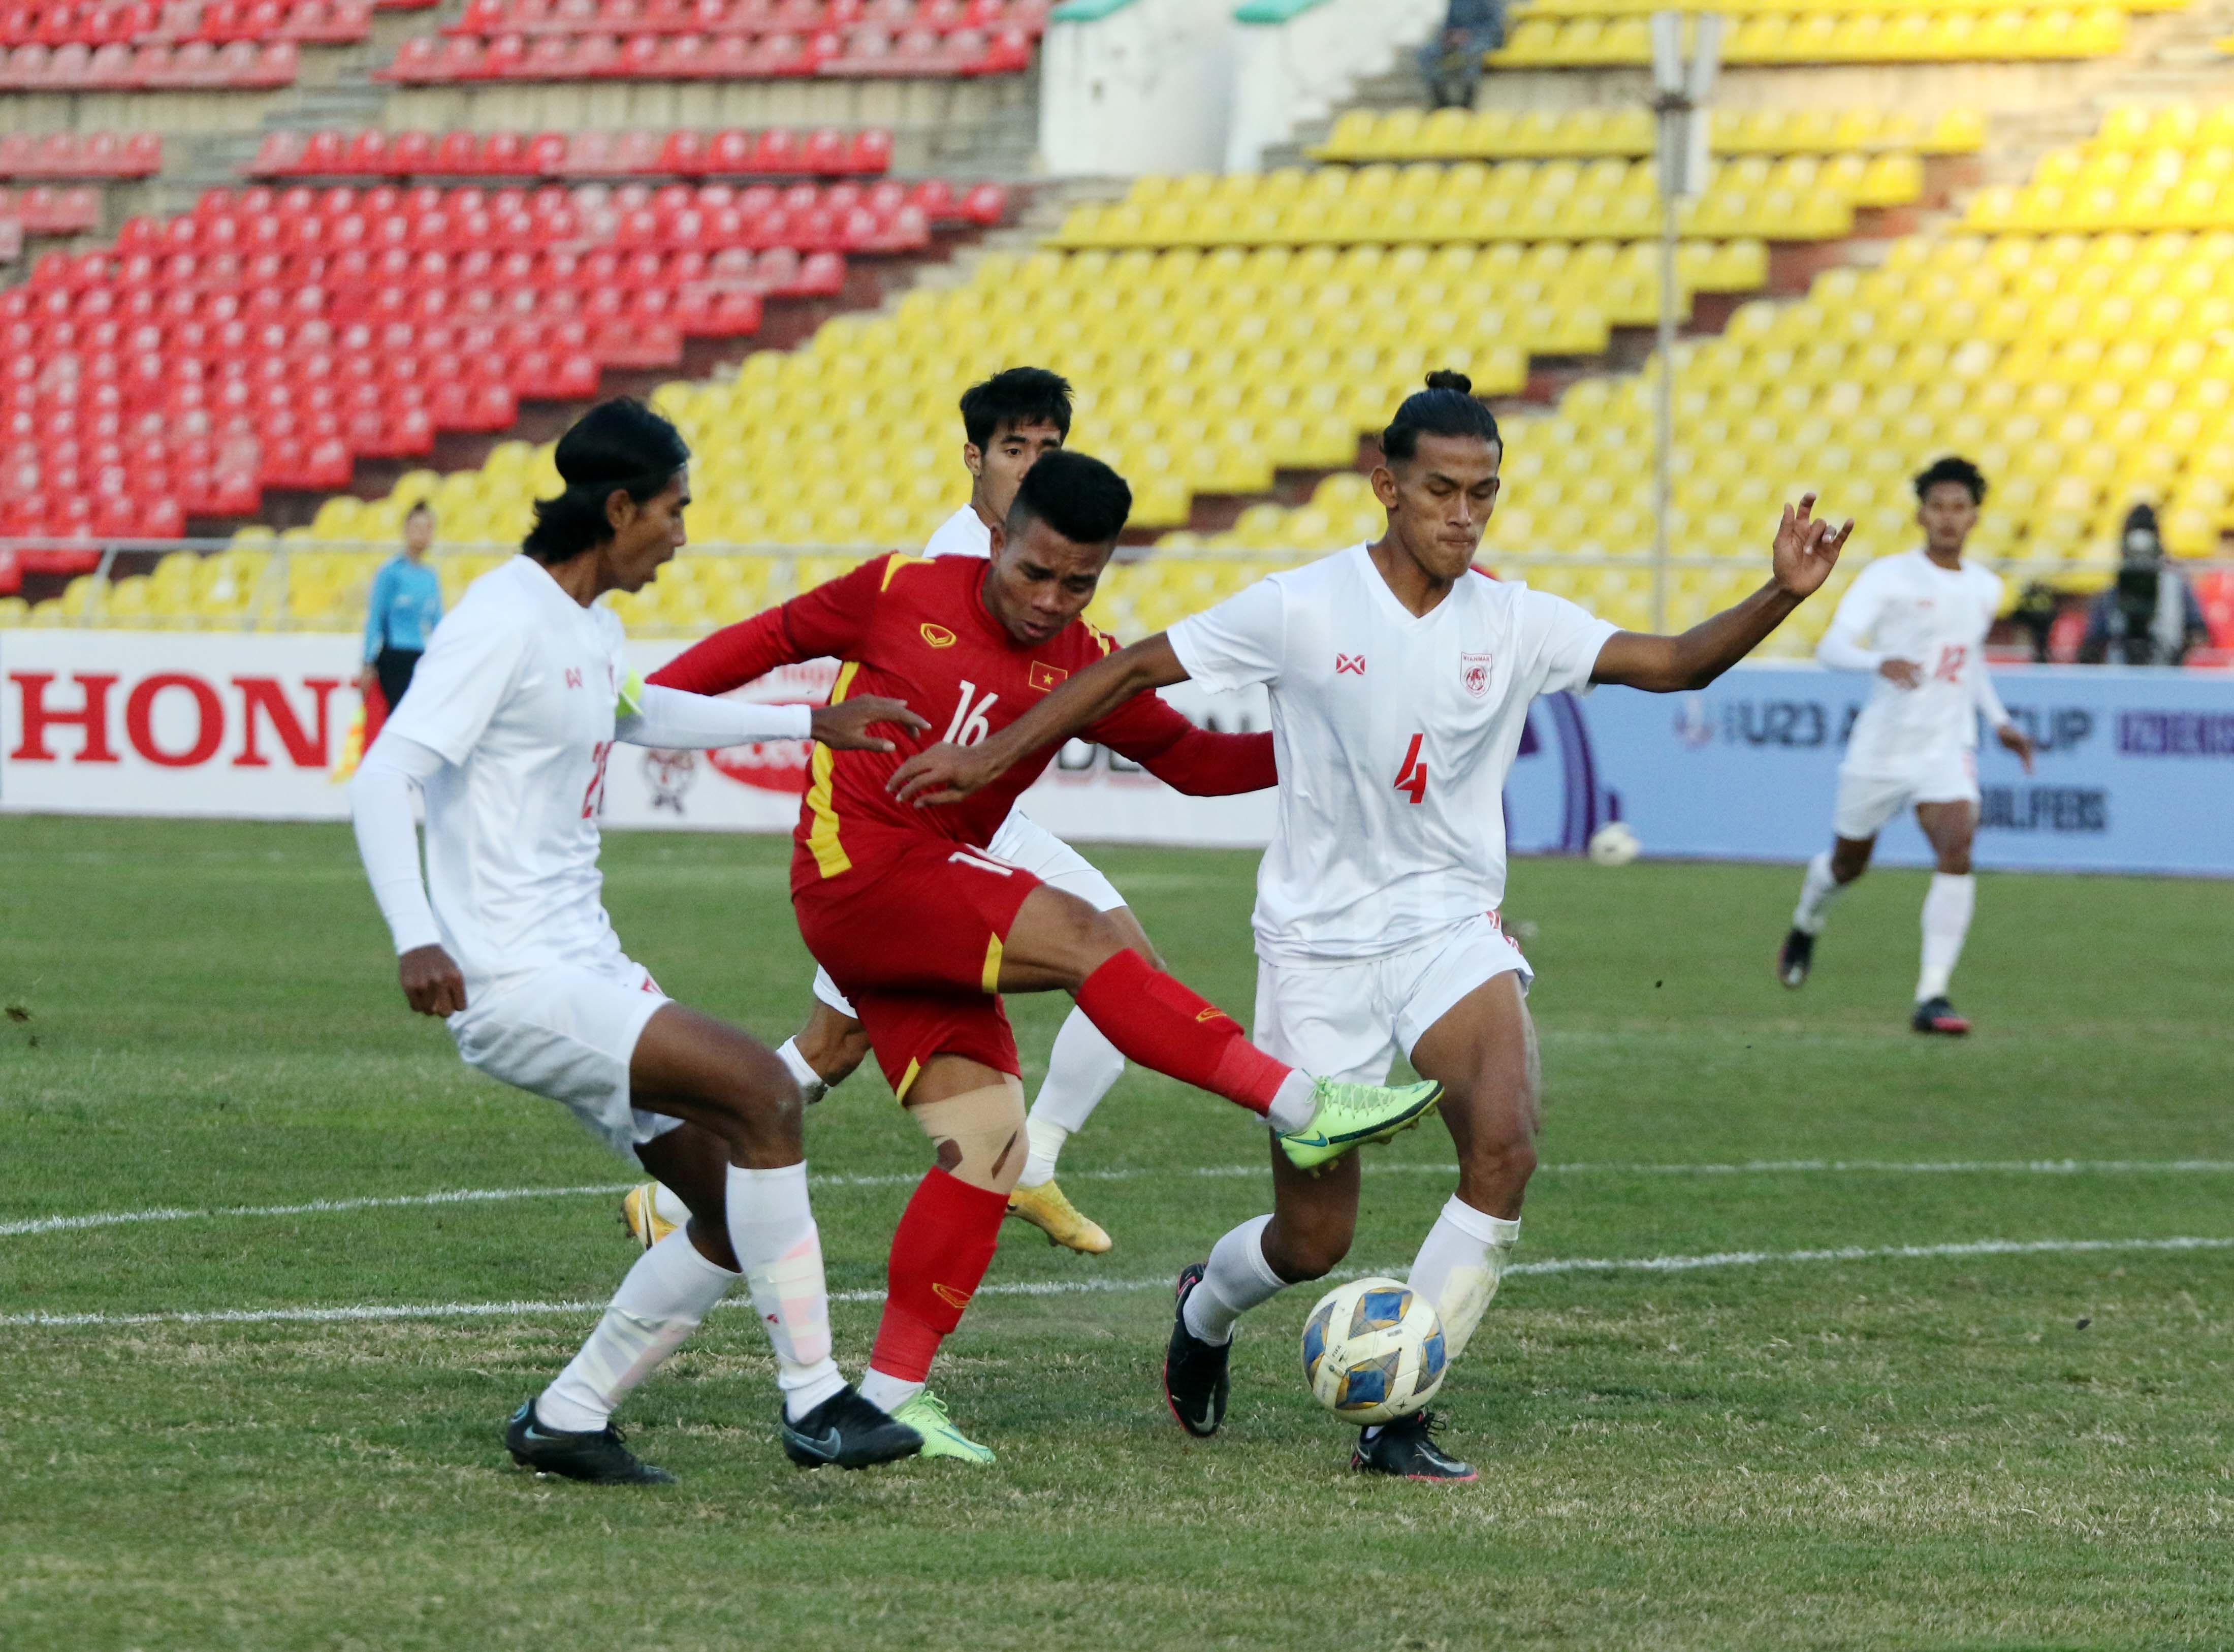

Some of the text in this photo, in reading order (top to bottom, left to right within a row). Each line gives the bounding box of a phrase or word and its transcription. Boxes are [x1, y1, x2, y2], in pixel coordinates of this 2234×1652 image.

[9, 671, 390, 767] HON
[942, 679, 999, 747] 16
[1394, 733, 1427, 804] 4
